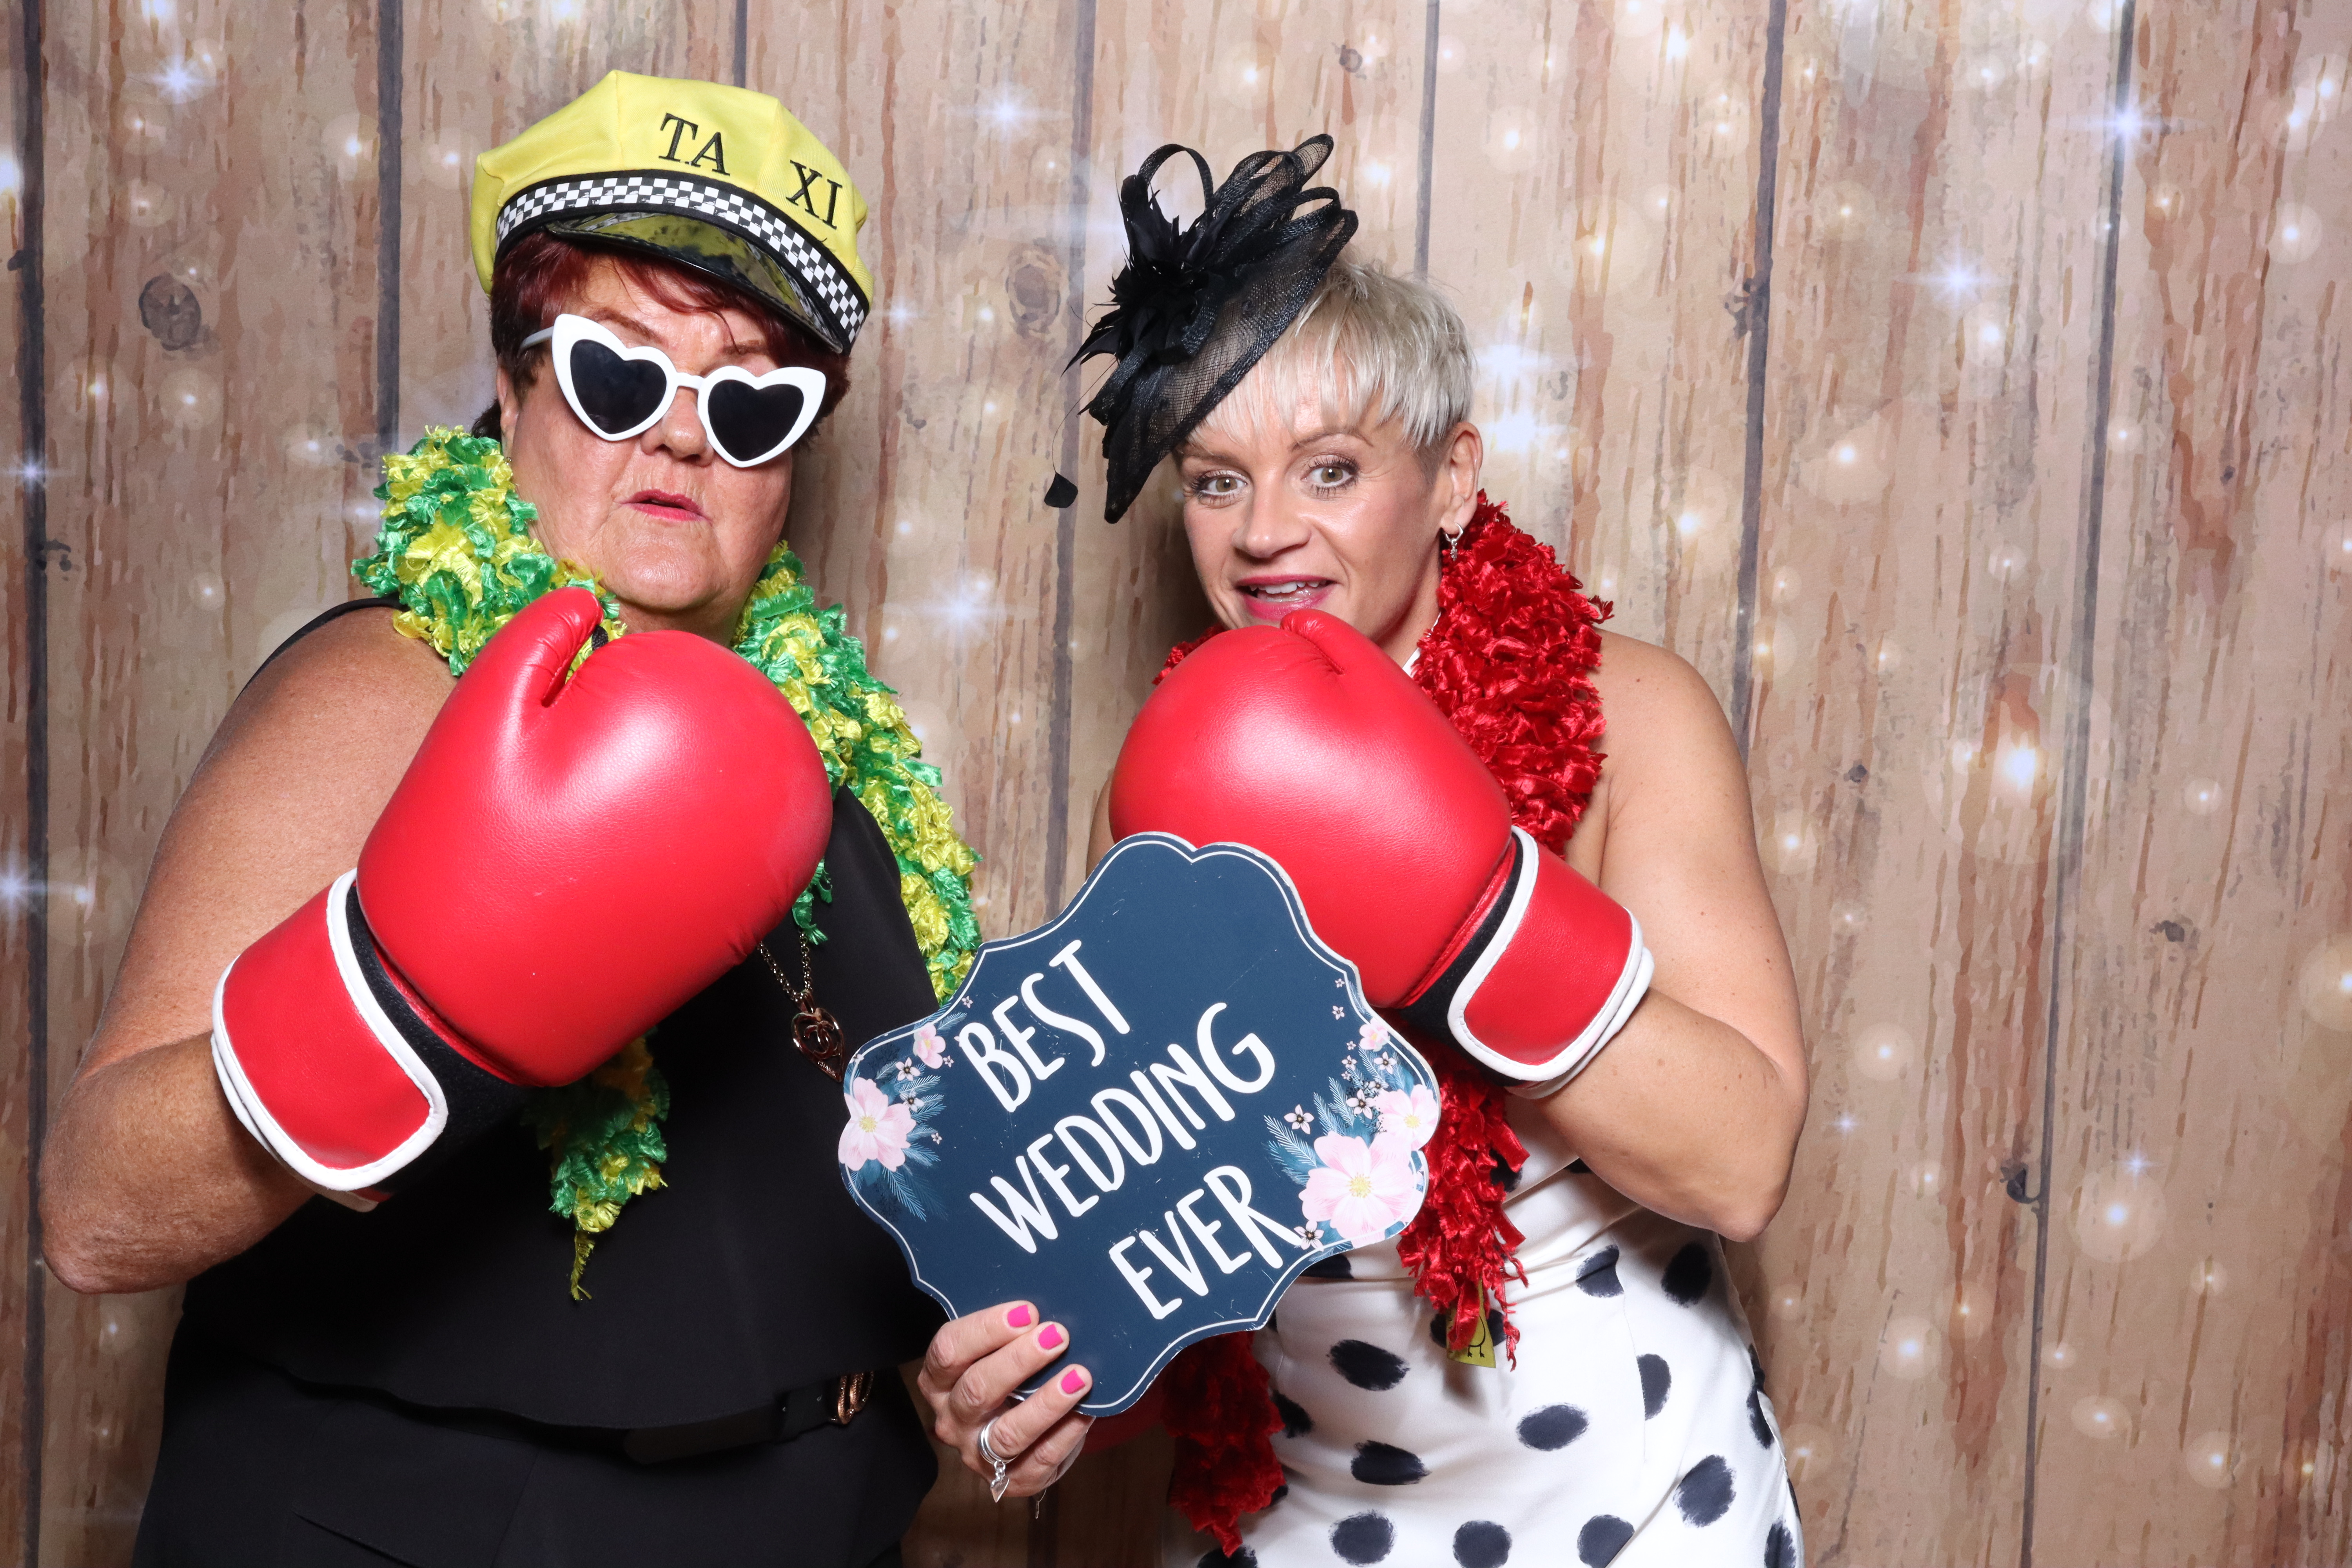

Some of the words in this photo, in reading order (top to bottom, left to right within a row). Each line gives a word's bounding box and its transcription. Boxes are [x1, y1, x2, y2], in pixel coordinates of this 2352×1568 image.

[959, 939, 1130, 1112] BEST
[969, 1002, 1275, 1254] WEDDING
[1109, 1165, 1302, 1319] EVER
